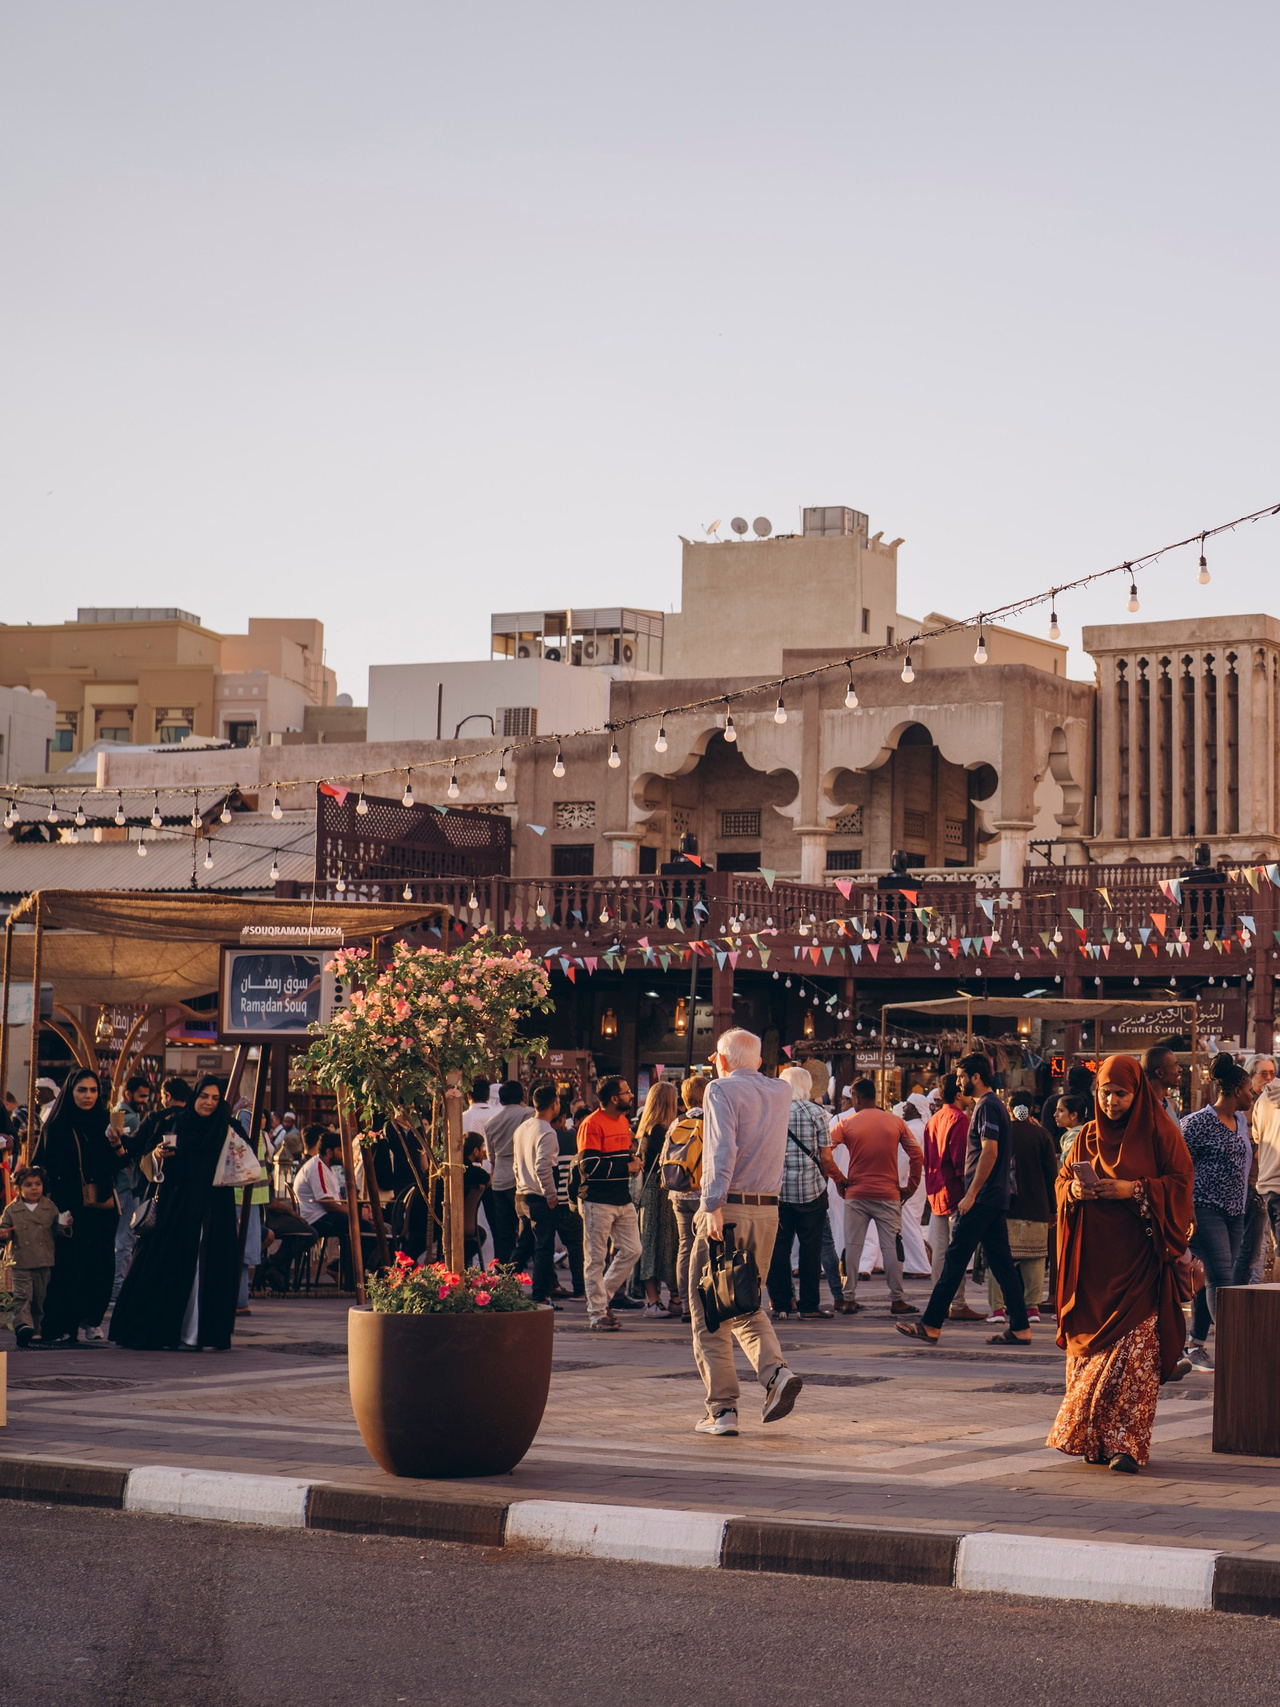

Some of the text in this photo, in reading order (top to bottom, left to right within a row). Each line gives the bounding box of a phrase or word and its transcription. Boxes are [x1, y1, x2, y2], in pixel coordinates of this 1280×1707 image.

[241, 925, 342, 936] #SOUQRAMADAN2024
[241, 974, 308, 994] سوق رمضان
[240, 997, 307, 1017] Ramadan Souq
[110, 1008, 129, 1036] رمضا
